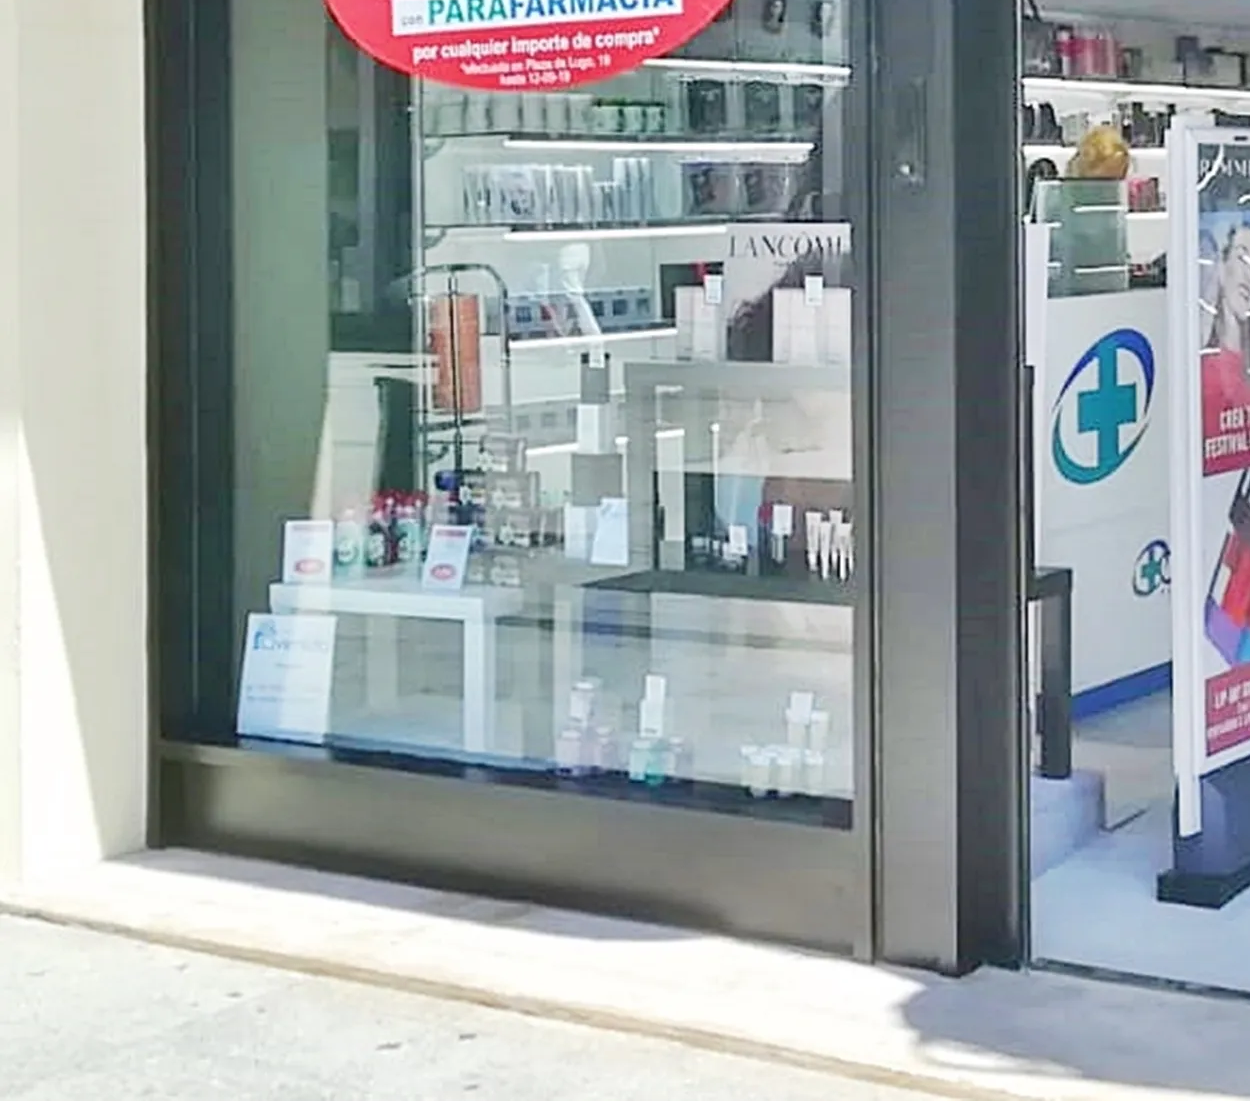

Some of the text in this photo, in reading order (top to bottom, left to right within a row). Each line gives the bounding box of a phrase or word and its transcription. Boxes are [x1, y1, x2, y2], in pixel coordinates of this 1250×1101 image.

[412, 44, 437, 65] por
[440, 37, 510, 63] cualquier
[511, 32, 570, 57] importe
[572, 29, 592, 50] de
